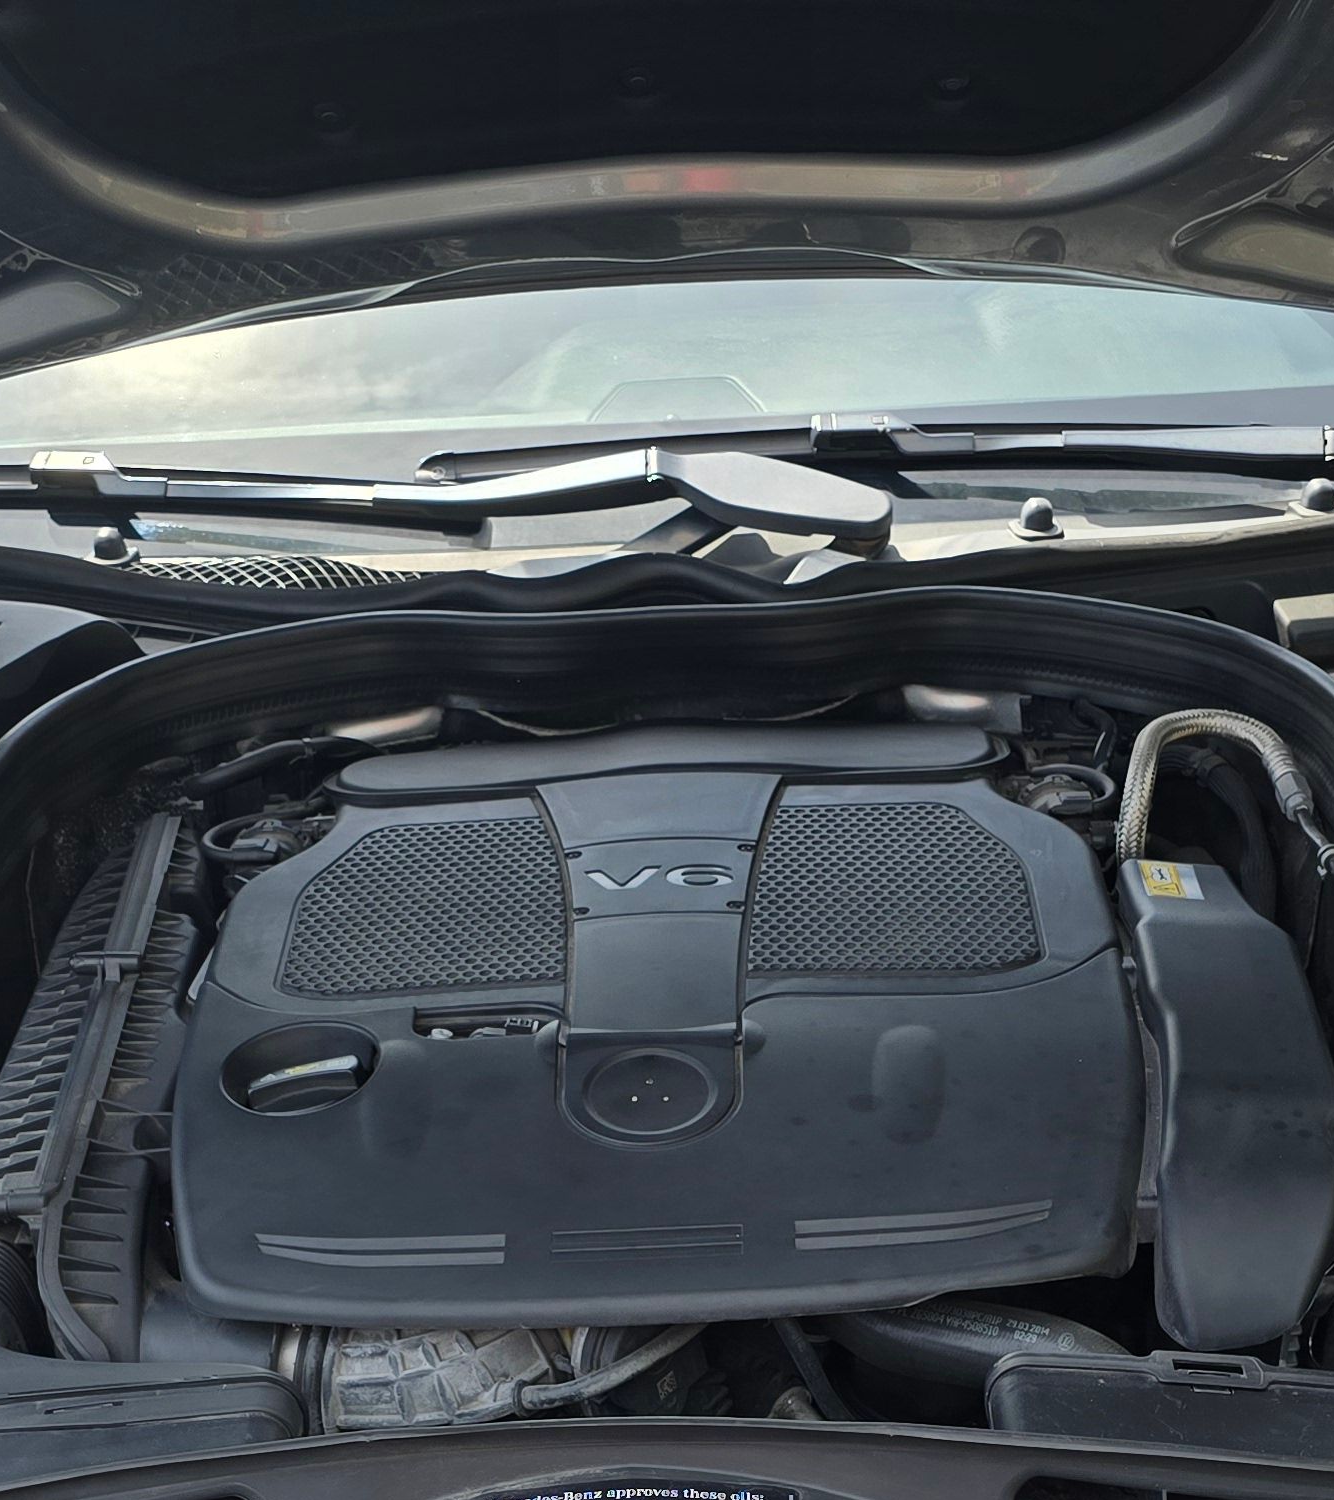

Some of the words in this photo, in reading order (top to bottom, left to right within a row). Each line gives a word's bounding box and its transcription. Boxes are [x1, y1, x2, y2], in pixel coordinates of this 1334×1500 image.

[583, 862, 735, 891] V6
[606, 1488, 679, 1500] approves
[683, 1488, 727, 1500] these
